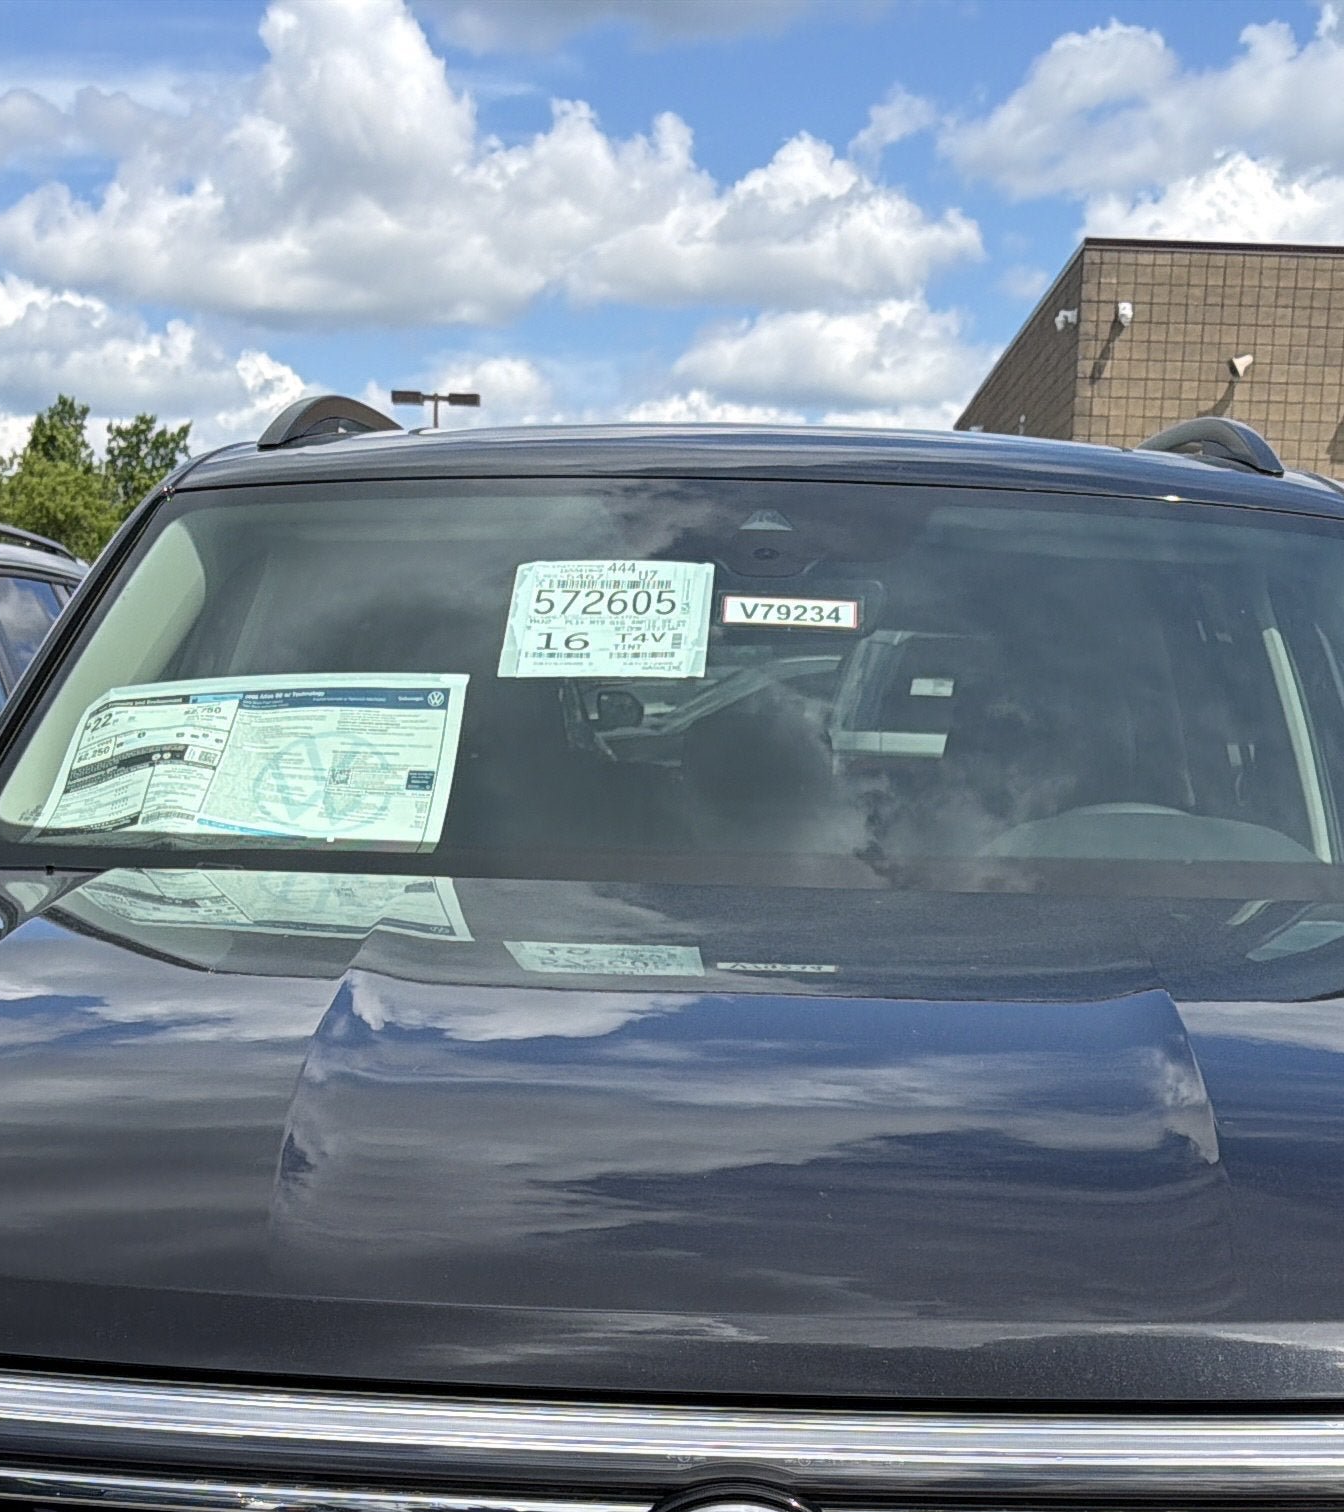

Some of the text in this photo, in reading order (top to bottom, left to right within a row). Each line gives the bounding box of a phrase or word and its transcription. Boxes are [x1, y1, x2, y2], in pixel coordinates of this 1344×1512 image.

[607, 562, 636, 574] 444
[533, 589, 676, 616] 572605
[740, 602, 842, 624] V79234
[537, 632, 667, 651] 16 T4V
[90, 712, 113, 733] 22
